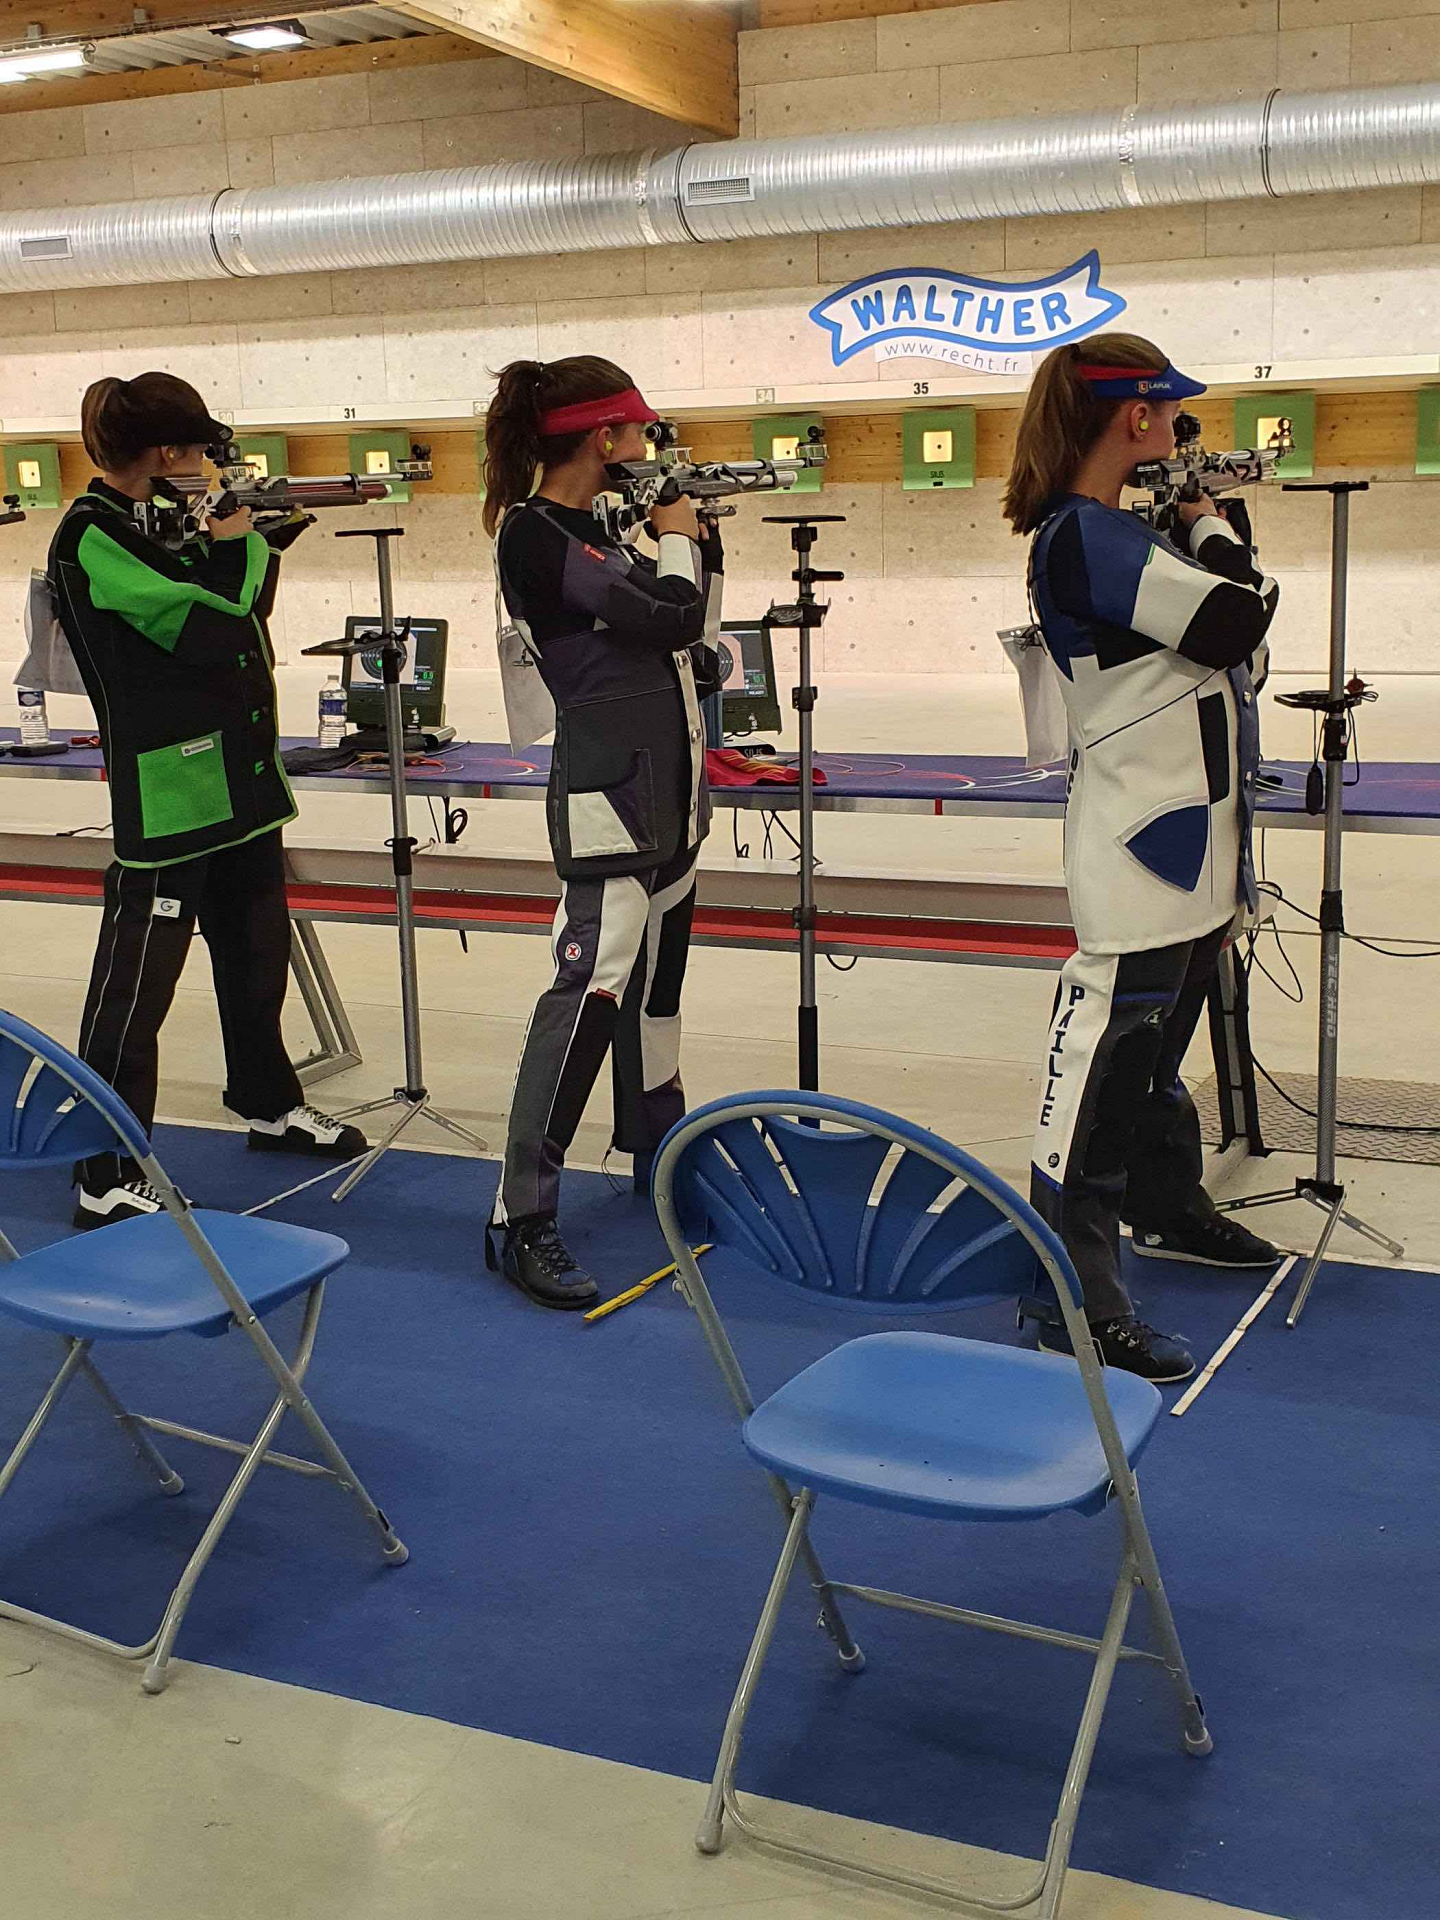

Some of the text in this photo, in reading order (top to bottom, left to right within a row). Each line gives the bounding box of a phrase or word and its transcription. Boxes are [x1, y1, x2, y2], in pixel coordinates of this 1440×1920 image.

[850, 284, 1072, 336] WALTHER
[884, 340, 1019, 372] www.recht.fr
[1254, 365, 1272, 379] 37
[913, 382, 929, 395] 35
[343, 407, 356, 419] 31
